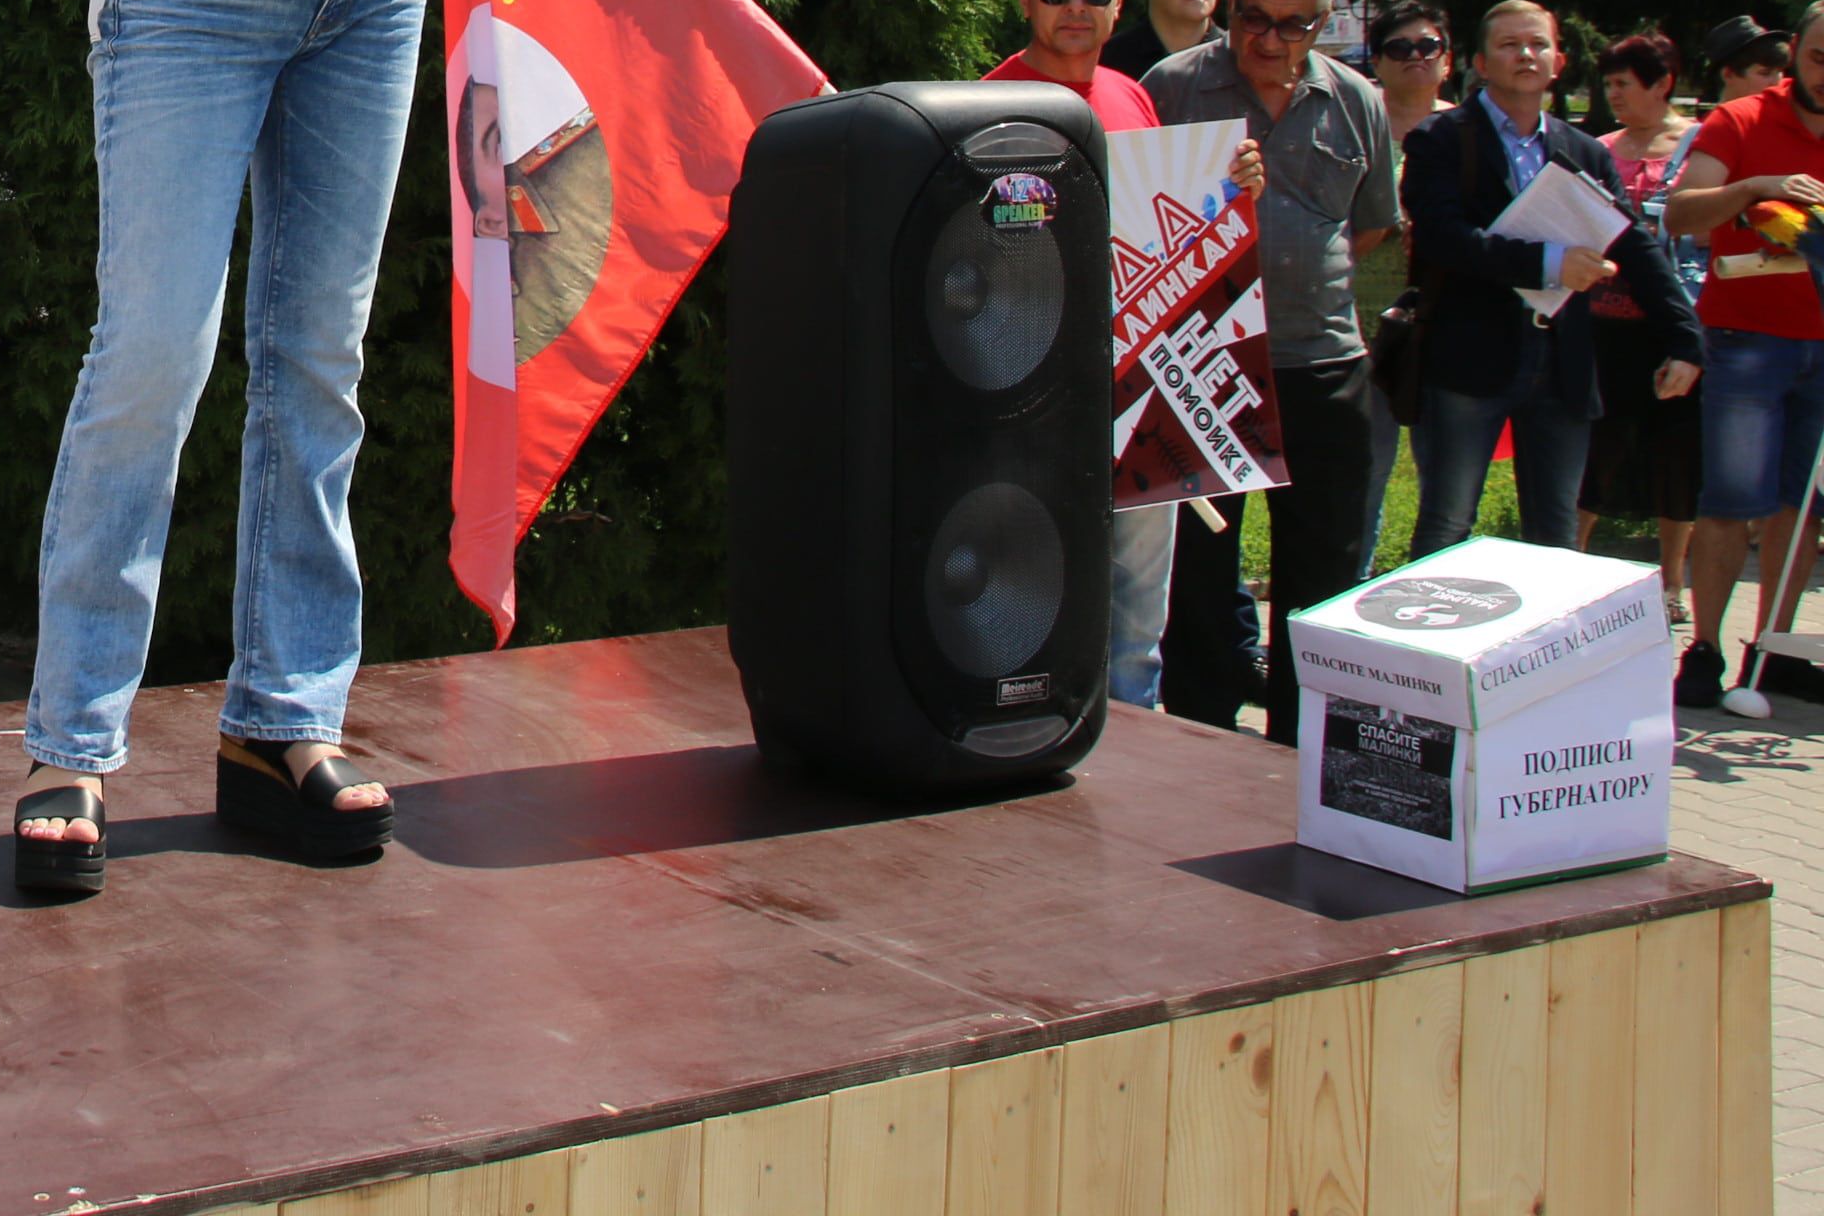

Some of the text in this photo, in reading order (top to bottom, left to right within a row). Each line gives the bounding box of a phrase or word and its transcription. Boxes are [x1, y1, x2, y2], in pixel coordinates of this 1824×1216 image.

[994, 203, 1045, 224] SPEAKER
[1110, 192, 1210, 307] ДА
[1113, 208, 1249, 367] АЛИНКАМ
[1170, 310, 1264, 424] НЕТ
[1430, 591, 1498, 610] MALINKI
[1480, 600, 1646, 691] СПАСИТЕ МАЛИНКИ
[1302, 650, 1443, 695] СПАСИТЕ МАЛИНКИ
[1358, 723, 1421, 750] СПАСИТЕ
[1358, 736, 1421, 764] МАЛИНКИ
[1523, 738, 1633, 775] ПОДПИСИ
[1498, 773, 1654, 819] ГУБЕРНАТОРУ
